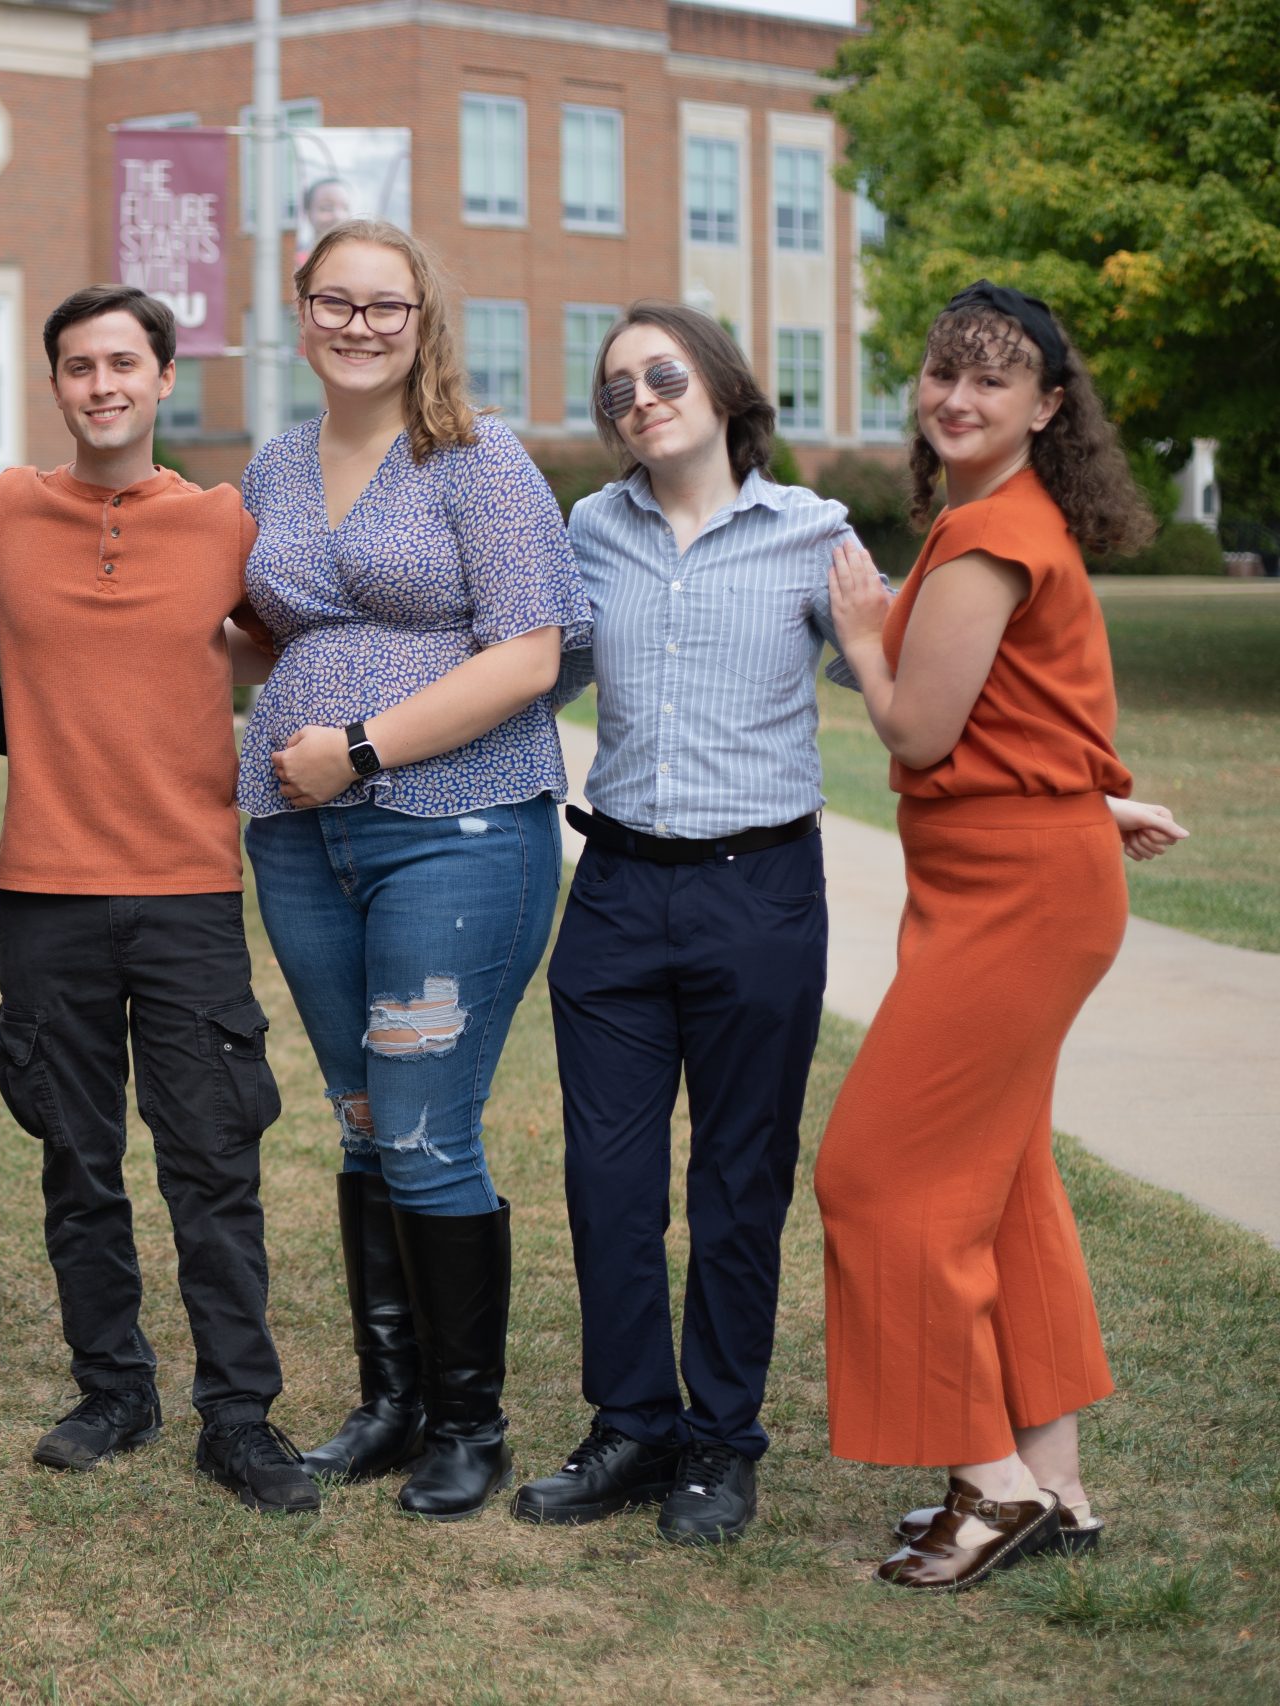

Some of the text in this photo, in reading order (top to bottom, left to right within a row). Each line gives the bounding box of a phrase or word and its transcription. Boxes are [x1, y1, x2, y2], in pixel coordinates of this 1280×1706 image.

[121, 159, 173, 199] THE
[120, 192, 219, 232] FUTURE
[120, 225, 220, 265] STARTS
